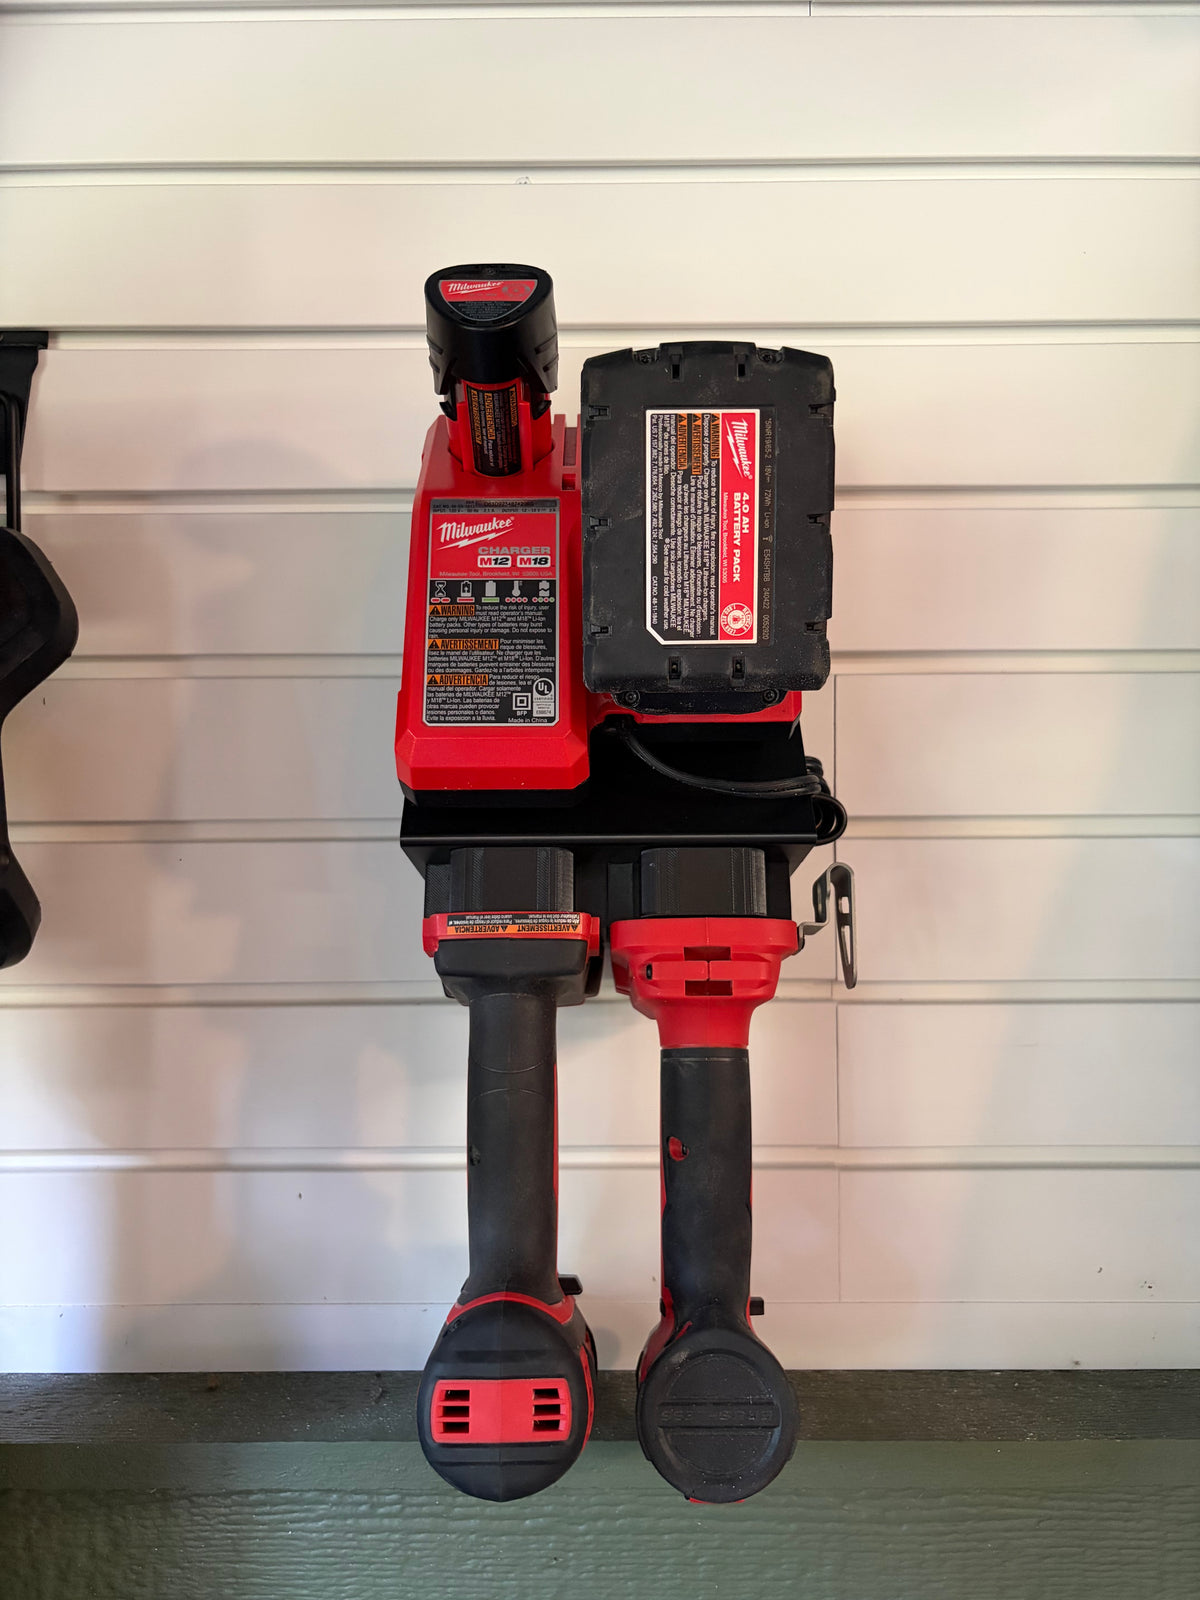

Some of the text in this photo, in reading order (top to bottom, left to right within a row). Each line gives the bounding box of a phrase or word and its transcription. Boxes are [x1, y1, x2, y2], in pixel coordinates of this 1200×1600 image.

[448, 281, 501, 293] Milwaukee
[678, 424, 687, 468] ADVERTENCIA
[711, 424, 720, 457] WARNING
[692, 424, 701, 473] AVERTISSEMENT
[731, 418, 752, 477] Milwaukee
[733, 492, 741, 546] BATTERY
[742, 516, 749, 533] AH
[437, 517, 512, 543] Milwaukee
[478, 546, 551, 555] CHARGER
[480, 557, 509, 565] M12
[520, 557, 549, 565] M18
[440, 605, 474, 615] WARNING
[440, 639, 499, 650] AVERTISSEMENT
[440, 675, 487, 685] ADVERTENCIA
[454, 925, 499, 933] ADVERTENCIA
[517, 924, 570, 932] AVERTISSEMENT
[660, 1410, 773, 1421] BRUSESS
